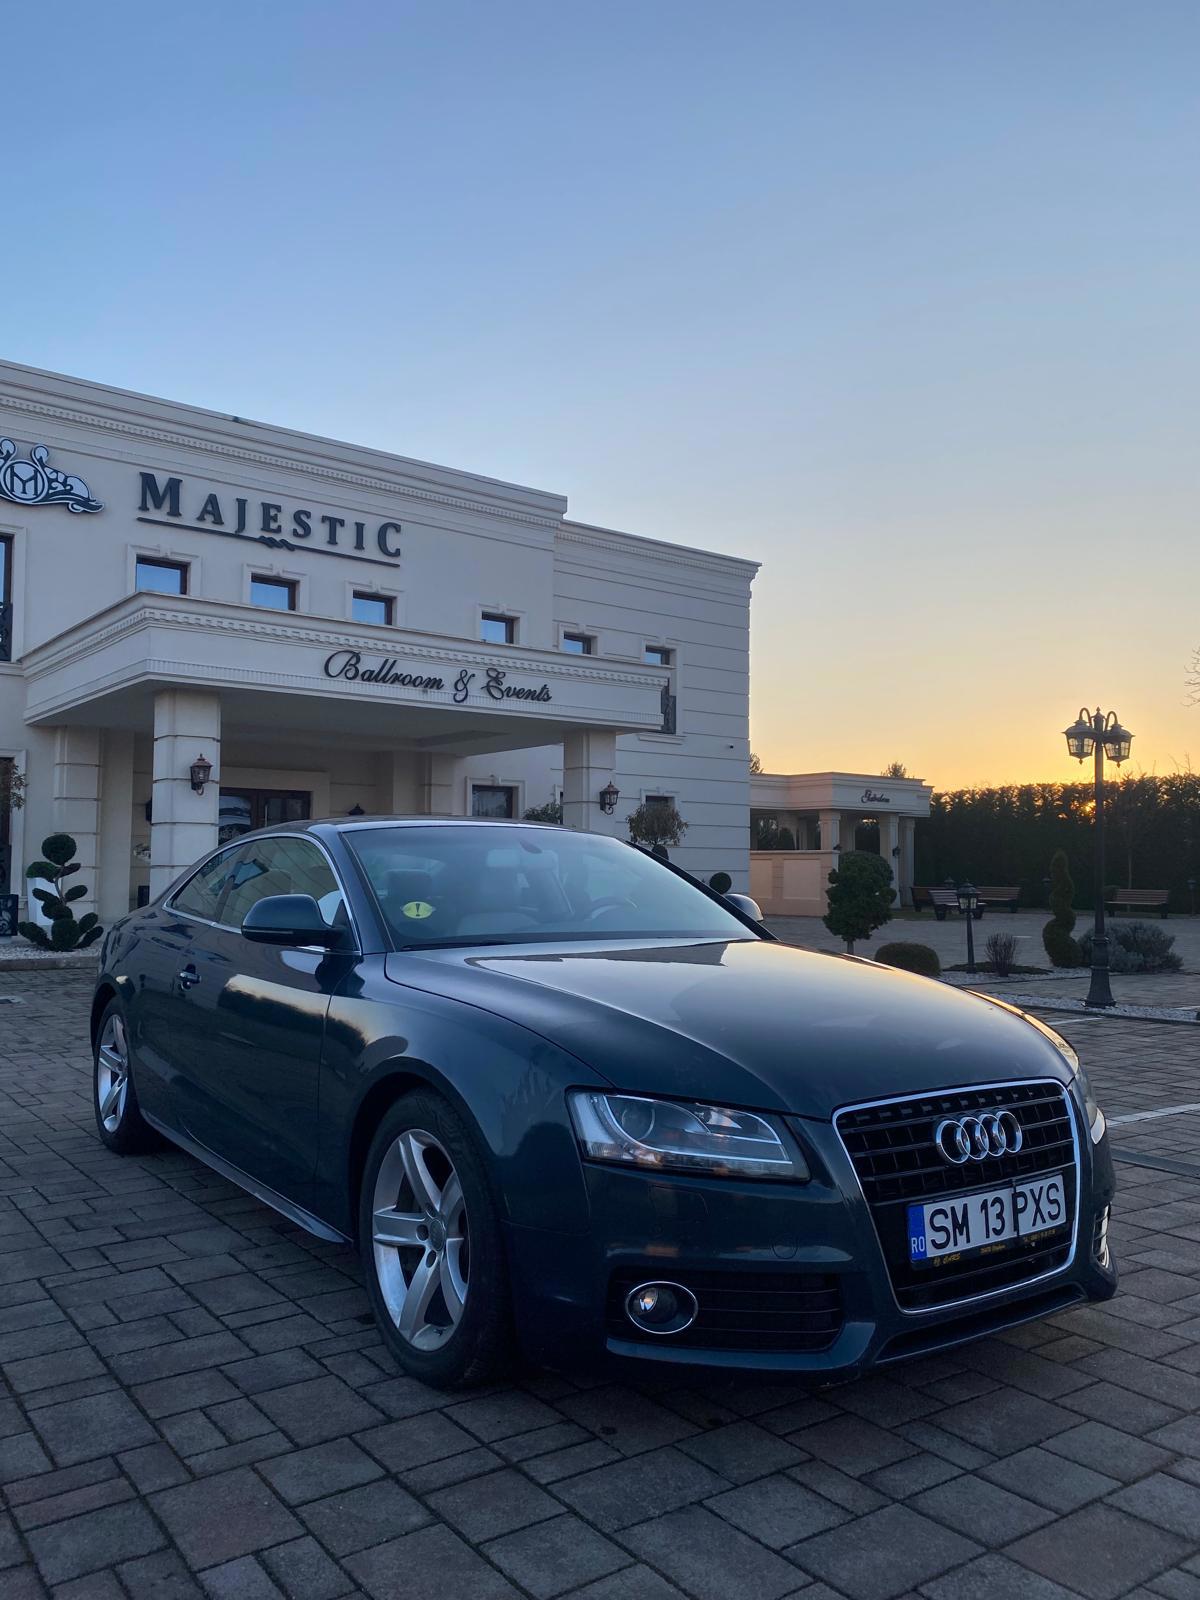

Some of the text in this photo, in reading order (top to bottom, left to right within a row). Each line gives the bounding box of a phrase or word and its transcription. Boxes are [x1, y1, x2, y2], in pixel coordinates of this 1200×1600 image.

[138, 471, 401, 557] MAJESTIC
[324, 650, 552, 703] Ballroom & Events
[911, 1235, 925, 1253] RO
[929, 1183, 1061, 1249] SM 13 PXS
